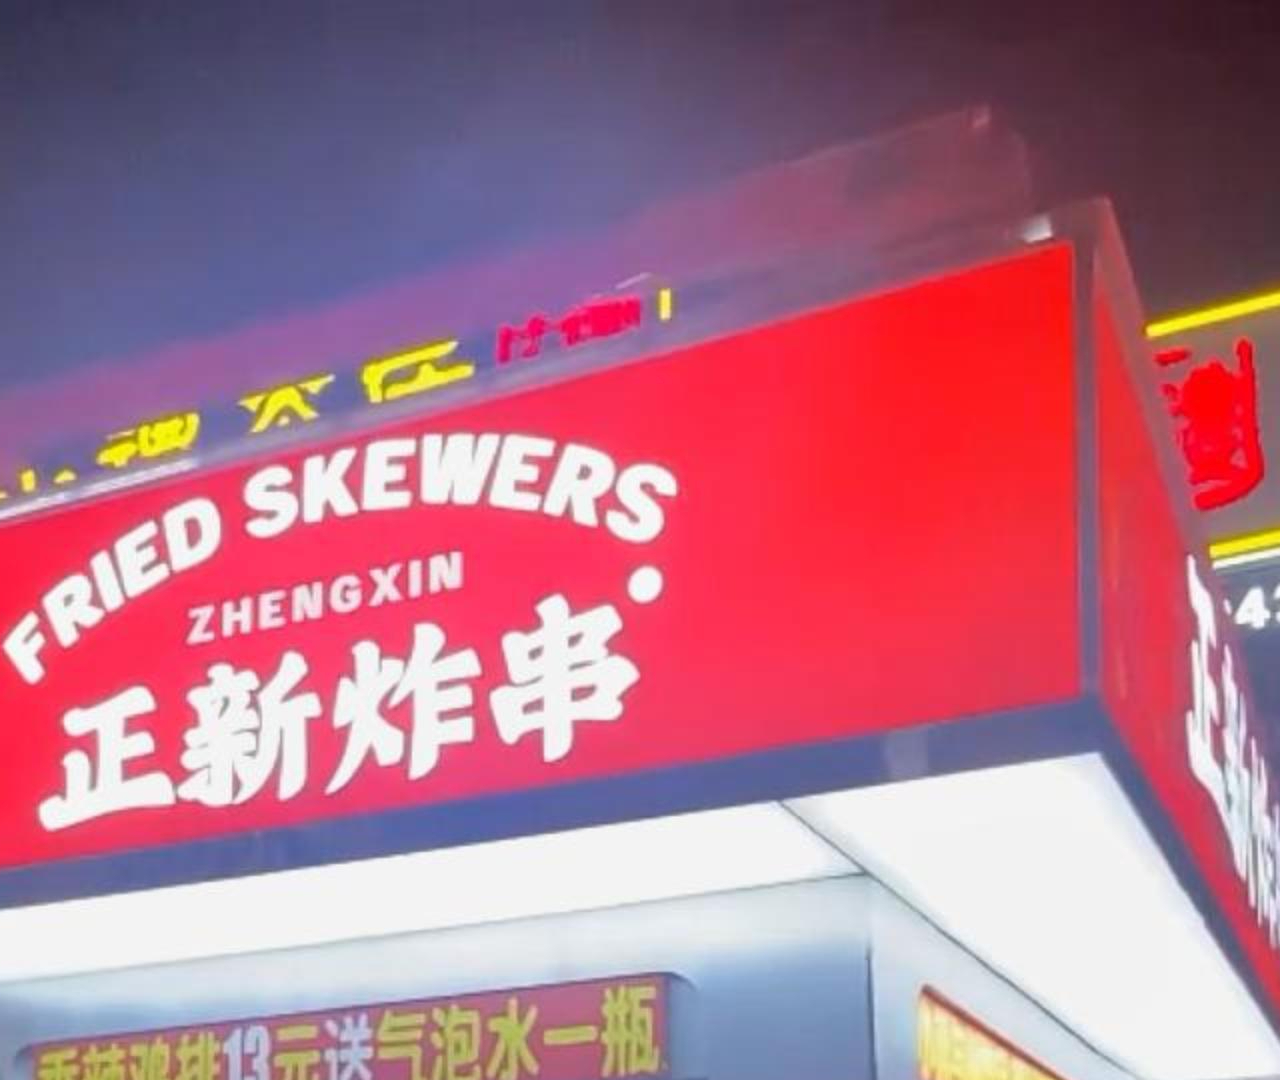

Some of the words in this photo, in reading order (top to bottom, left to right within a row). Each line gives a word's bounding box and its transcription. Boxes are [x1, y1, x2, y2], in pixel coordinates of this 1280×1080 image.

[2, 497, 222, 684] FRIED
[243, 433, 677, 542] SKEWERS
[186, 551, 464, 645] ZHENGXIN
[38, 594, 641, 832] 正新炸串
